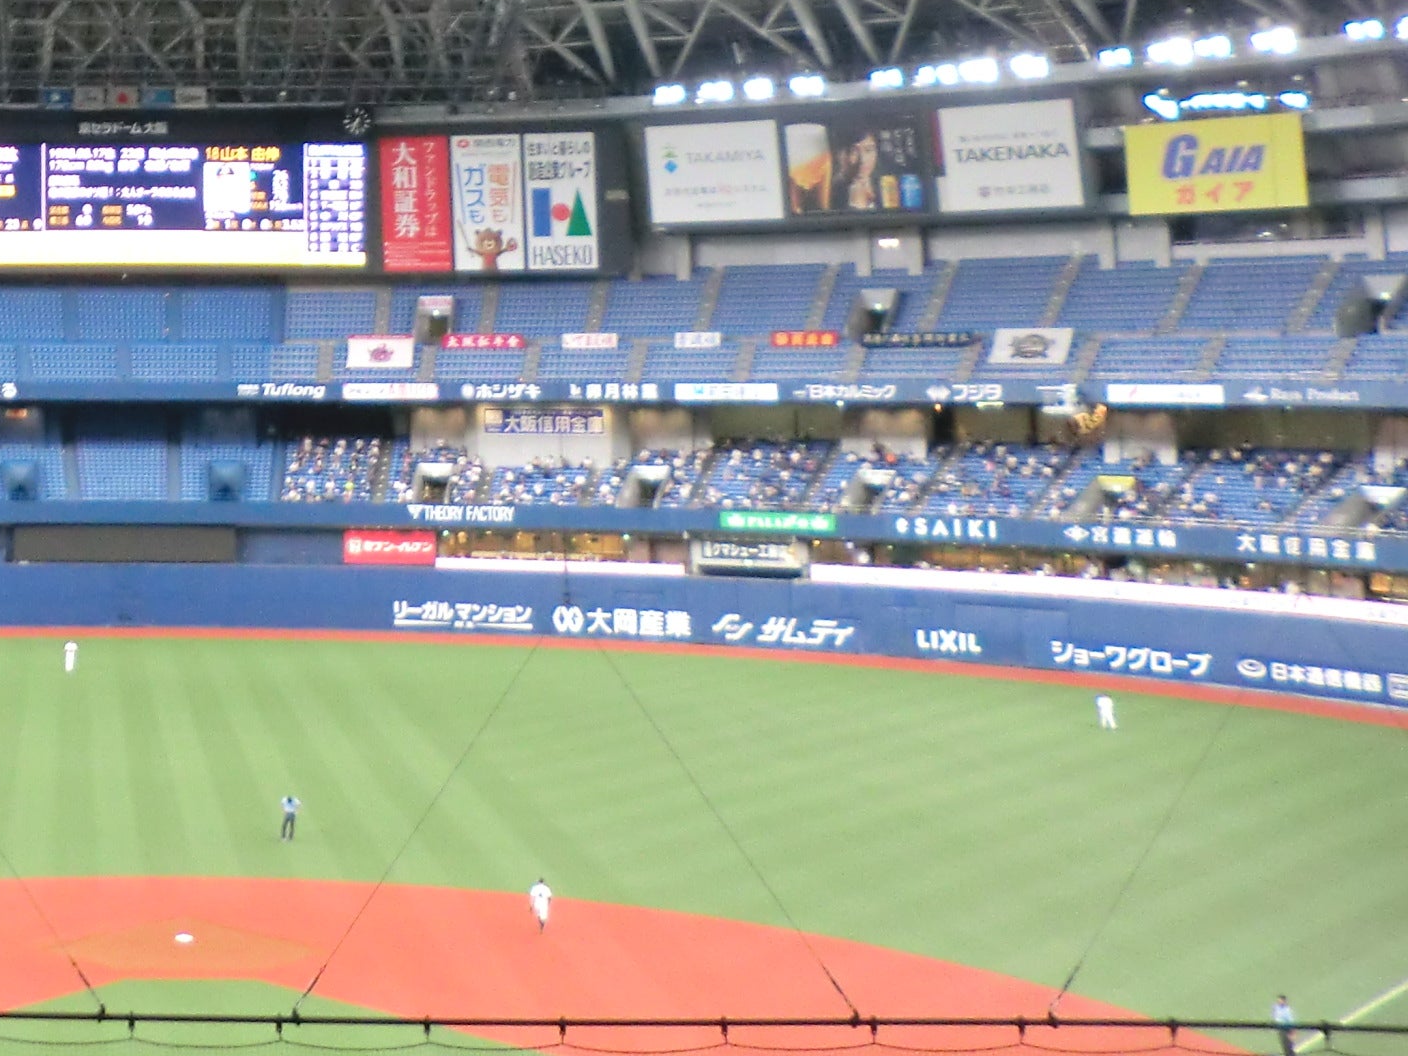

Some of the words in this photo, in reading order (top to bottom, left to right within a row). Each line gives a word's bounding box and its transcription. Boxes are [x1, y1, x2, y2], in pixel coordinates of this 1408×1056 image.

[953, 143, 1070, 163] TAKENAKA
[1162, 133, 1266, 181] GAIA
[392, 142, 421, 239] 大和証券
[464, 163, 488, 224] ガスも
[1175, 181, 1255, 204] ガイア
[532, 244, 592, 266] HASEKO
[262, 383, 326, 399] Tuflong
[475, 383, 542, 399] ホシザキ
[808, 384, 896, 399] 日本カルミック
[952, 384, 1003, 400] フジタ
[424, 505, 464, 522] THEORY
[465, 505, 515, 523] FACTORY
[915, 629, 982, 654] LIXIL
[1050, 640, 1212, 676] ショーワグローブ
